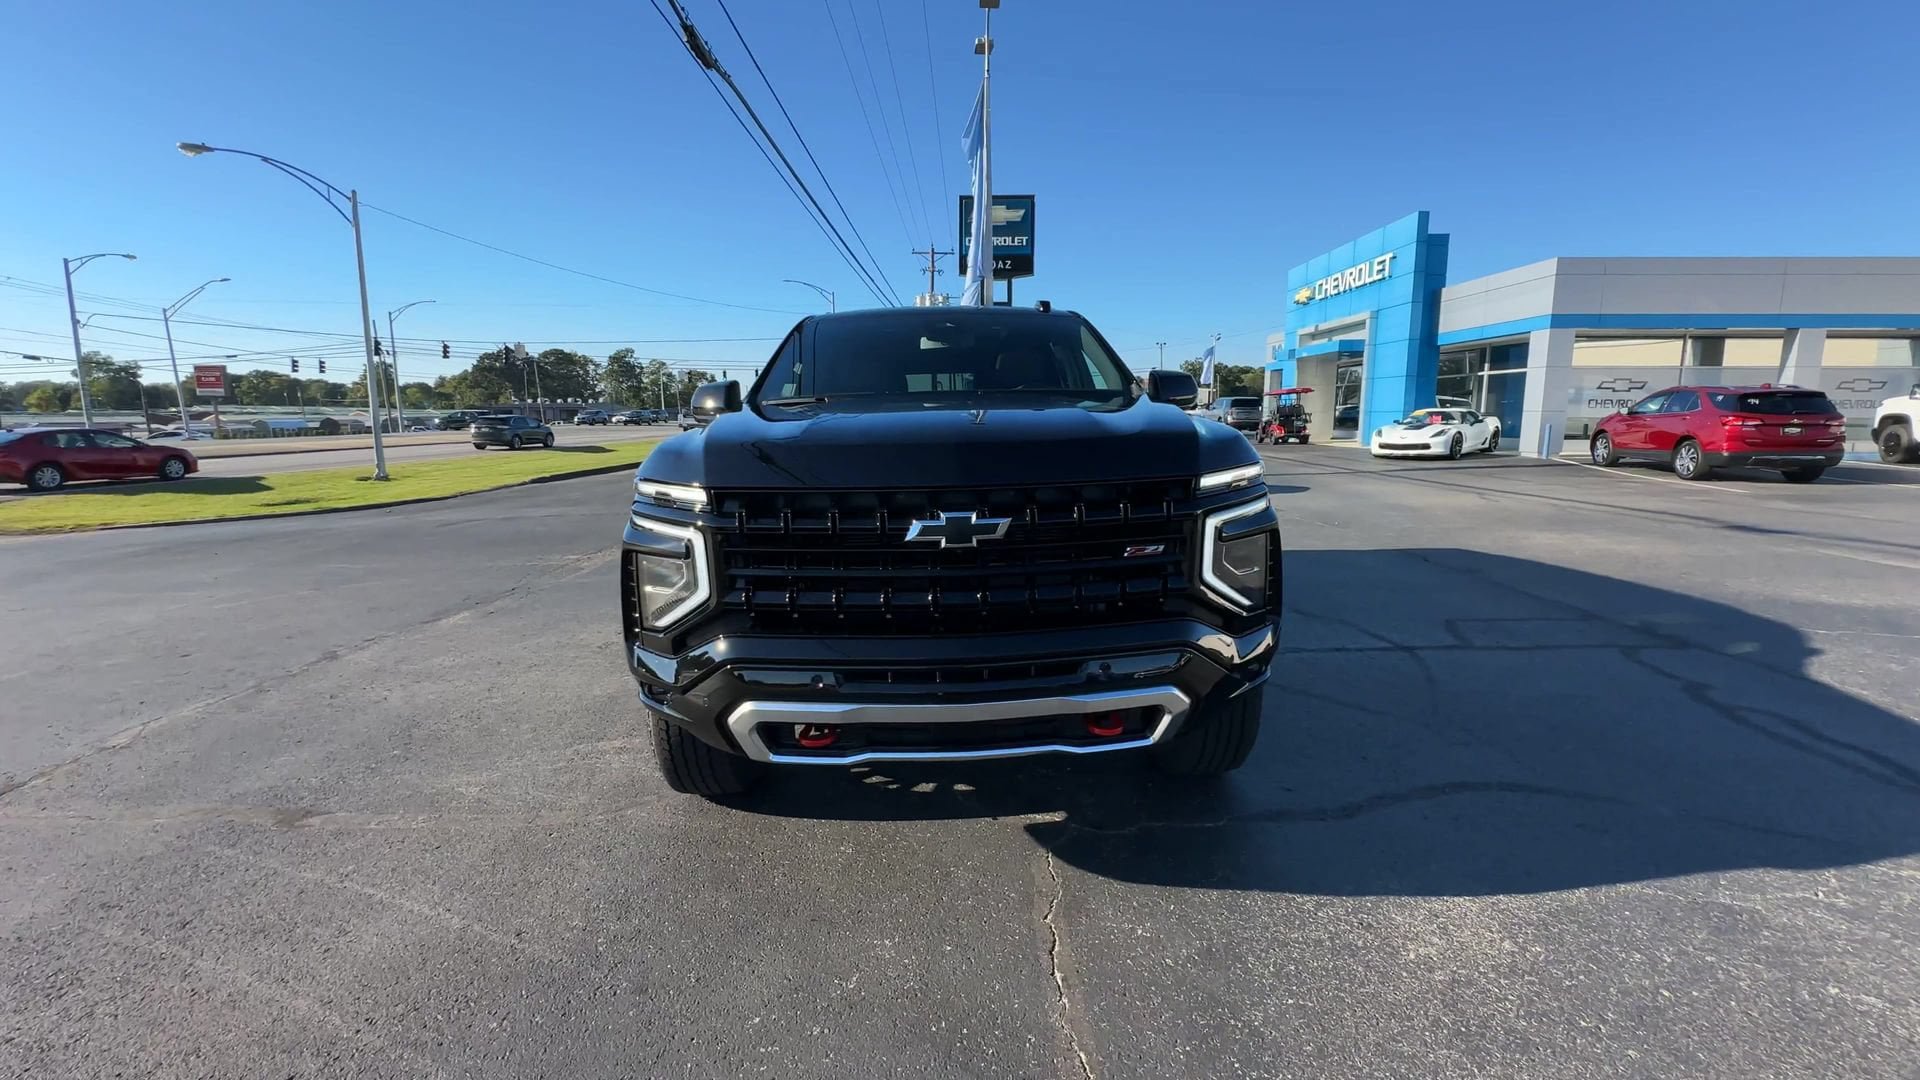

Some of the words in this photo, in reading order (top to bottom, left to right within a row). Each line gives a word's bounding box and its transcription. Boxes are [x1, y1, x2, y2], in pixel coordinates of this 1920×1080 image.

[965, 236, 1029, 246] CROLET
[1315, 251, 1394, 300] CHEVROLET
[1588, 399, 1636, 409] CHEVRO
